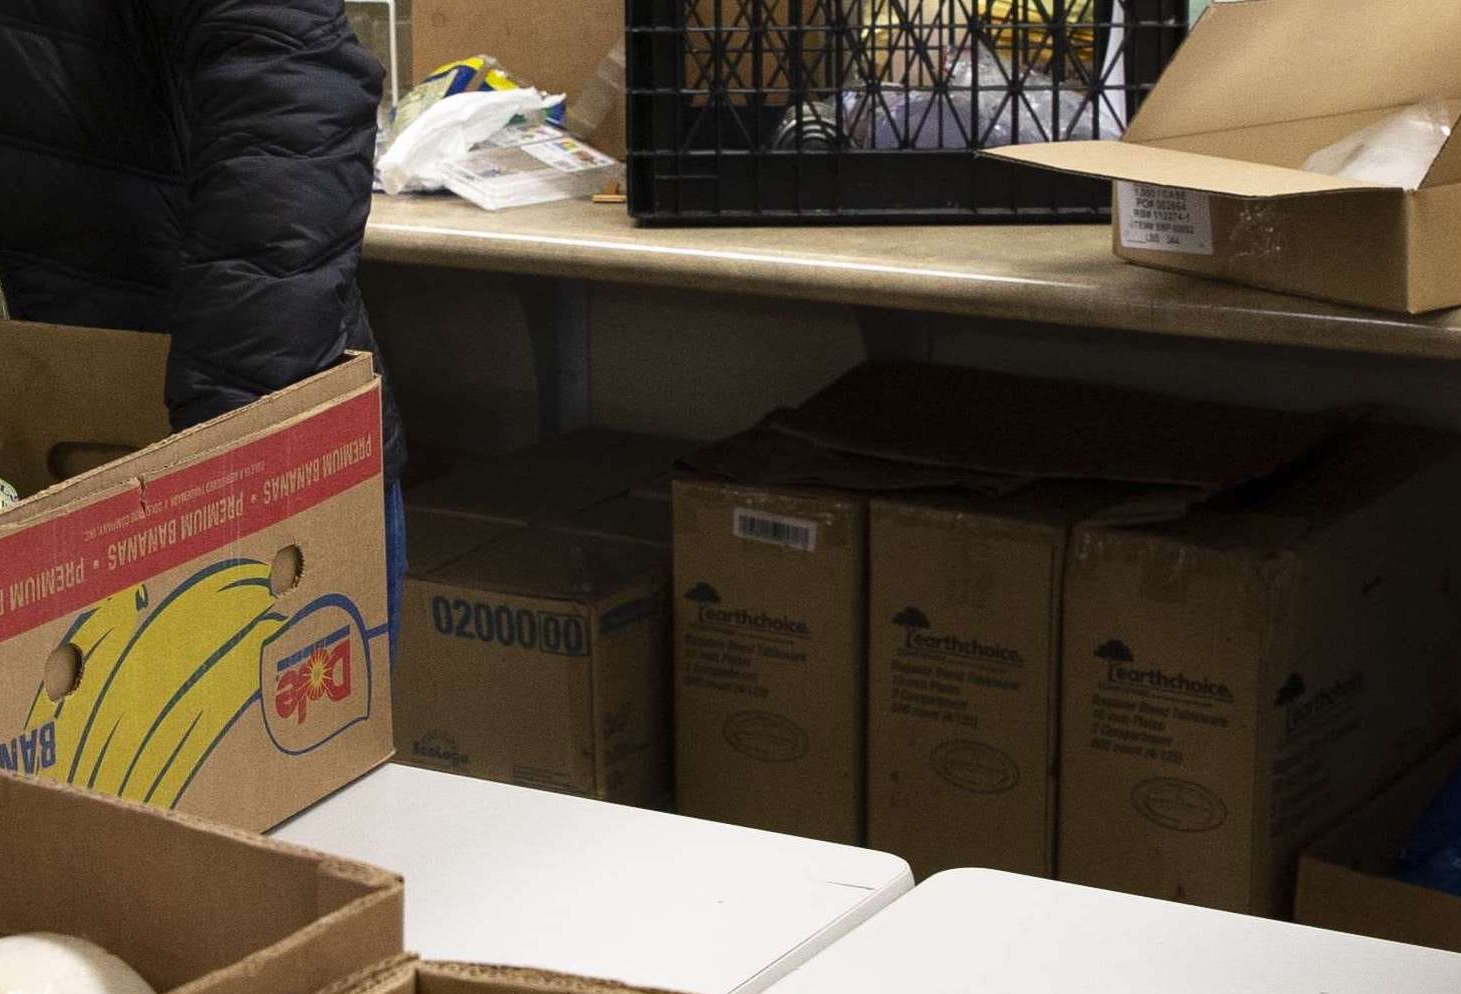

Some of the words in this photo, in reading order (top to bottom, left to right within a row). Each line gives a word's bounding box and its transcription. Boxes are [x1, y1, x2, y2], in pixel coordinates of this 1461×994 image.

[262, 458, 320, 504] BANANAS
[321, 432, 373, 479] PREMIUM
[179, 491, 244, 542] PREMIUM
[107, 518, 177, 571] BANANAS
[9, 556, 85, 611] PREMIUM
[275, 638, 352, 726] Dole
